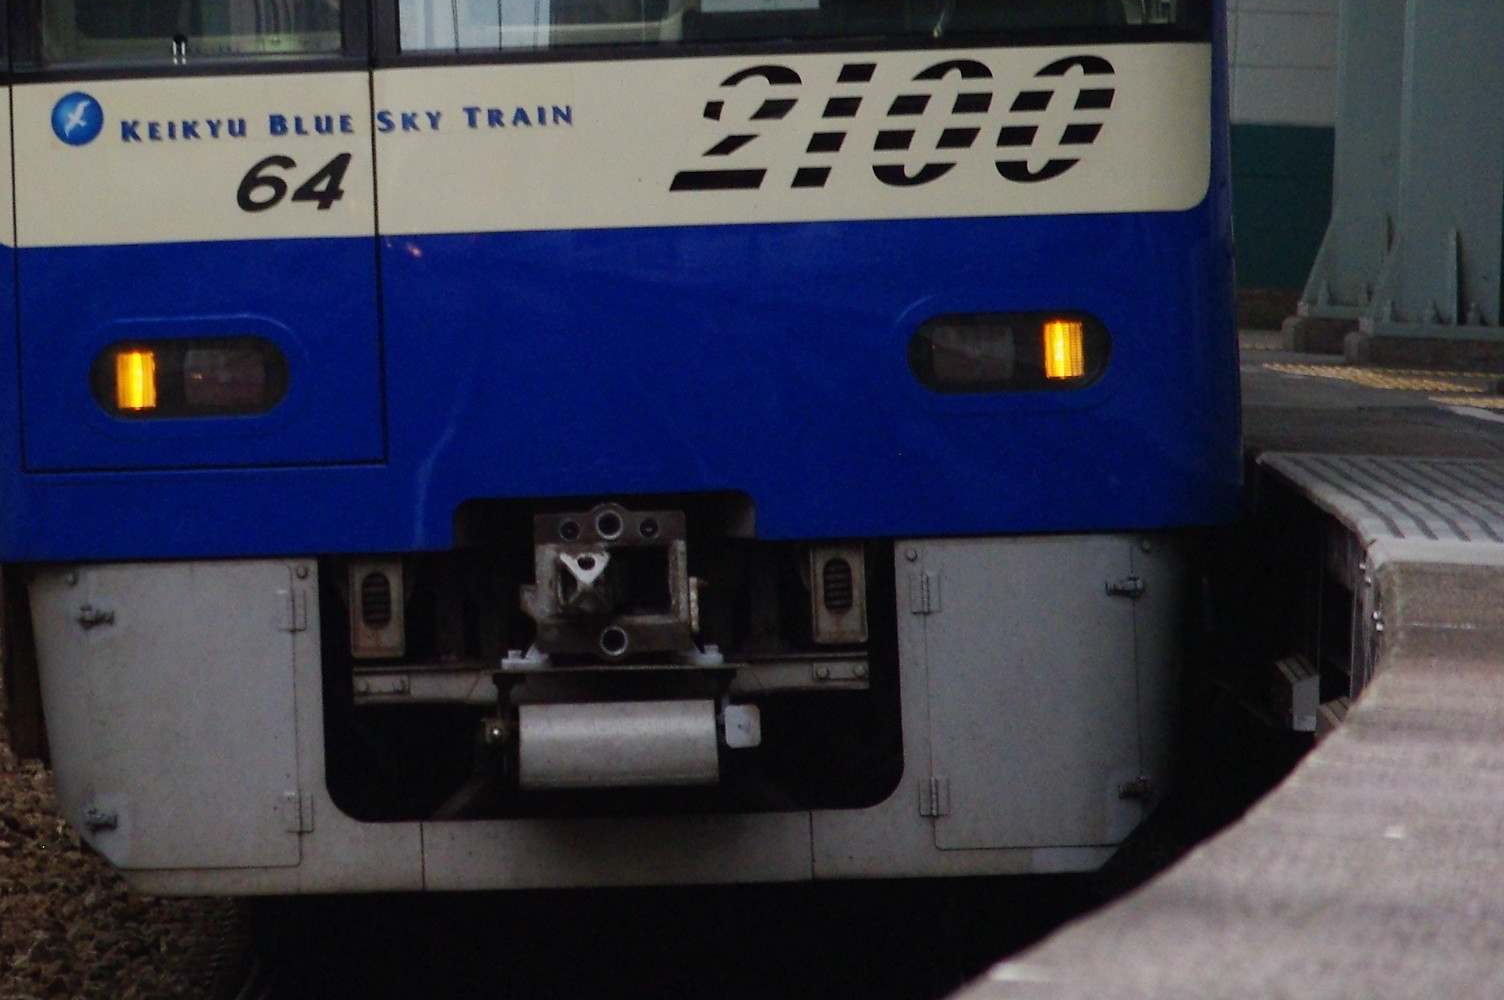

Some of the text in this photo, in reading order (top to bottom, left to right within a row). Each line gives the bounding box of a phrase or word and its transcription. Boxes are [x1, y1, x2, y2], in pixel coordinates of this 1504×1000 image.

[121, 104, 574, 142] KEIKYU BLUE SKY TRAIN
[669, 55, 1115, 191] 2100
[236, 152, 352, 214] 64
